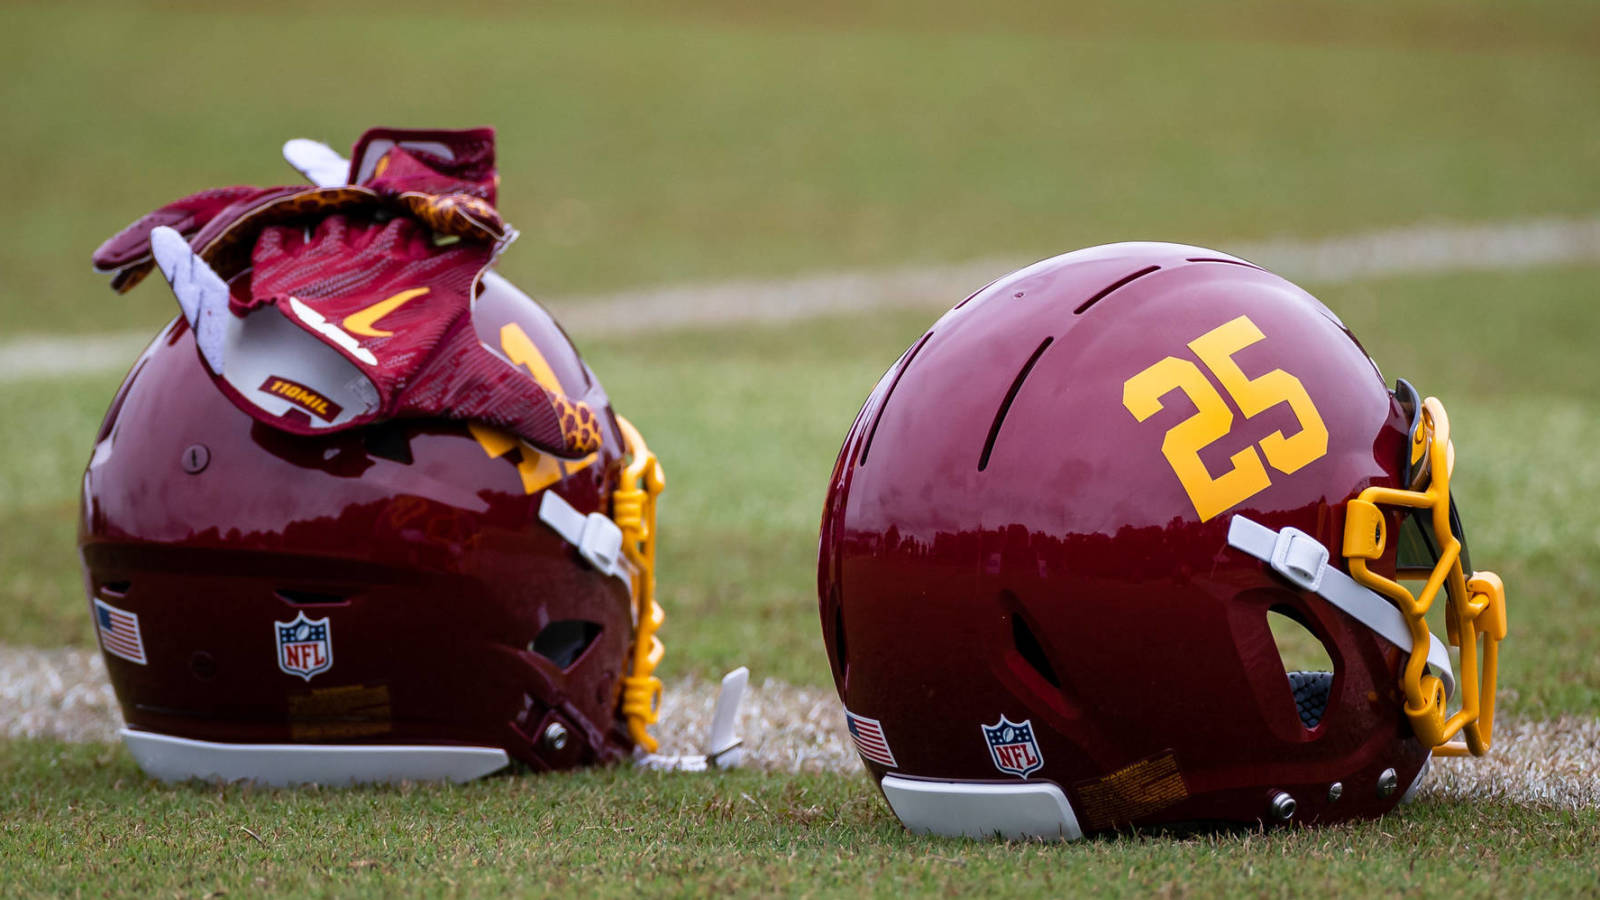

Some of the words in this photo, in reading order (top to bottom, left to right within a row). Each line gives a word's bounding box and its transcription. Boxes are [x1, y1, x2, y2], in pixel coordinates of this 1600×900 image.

[1122, 314, 1329, 523] 25
[286, 643, 326, 669] NFL
[996, 744, 1038, 770] NFL
